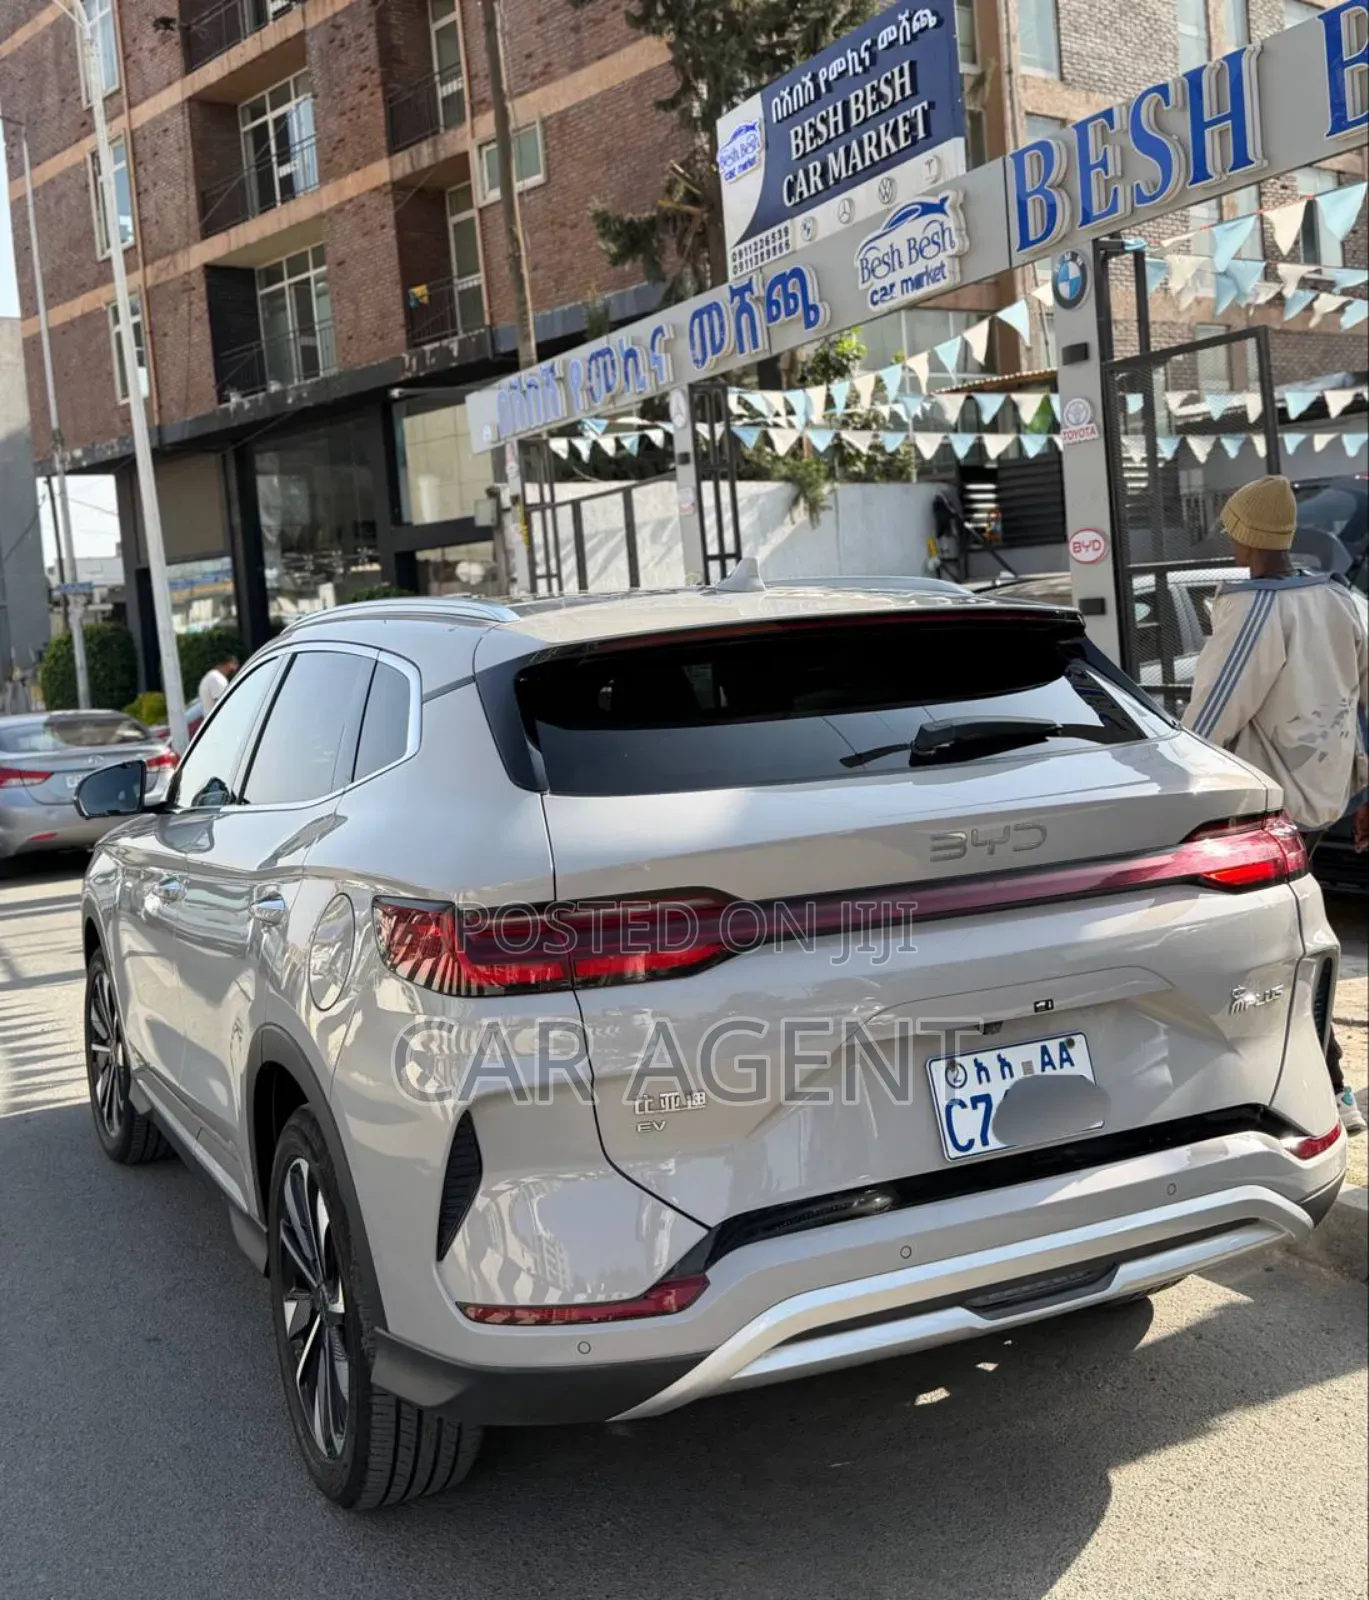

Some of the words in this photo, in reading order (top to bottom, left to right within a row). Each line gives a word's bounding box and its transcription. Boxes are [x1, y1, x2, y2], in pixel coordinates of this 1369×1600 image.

[819, 38, 872, 93] የመኪና
[790, 99, 844, 160] BESH
[850, 60, 912, 127] BESH
[783, 160, 825, 207] CAR
[827, 100, 928, 185] MARKET
[1009, 45, 1255, 252] BESH
[860, 246, 904, 284] Besh
[907, 219, 956, 266] Besh
[870, 282, 896, 306] car
[901, 260, 947, 295] market
[570, 324, 667, 413] የመኪና
[689, 266, 820, 370] መሸጫ
[1063, 426, 1096, 440] TOYOTA
[1073, 540, 1101, 553] BYD
[930, 823, 1048, 862] BYD
[1040, 1041, 1075, 1073] AA
[635, 1091, 706, 1115] 比亚迪
[637, 1120, 666, 1132] EV
